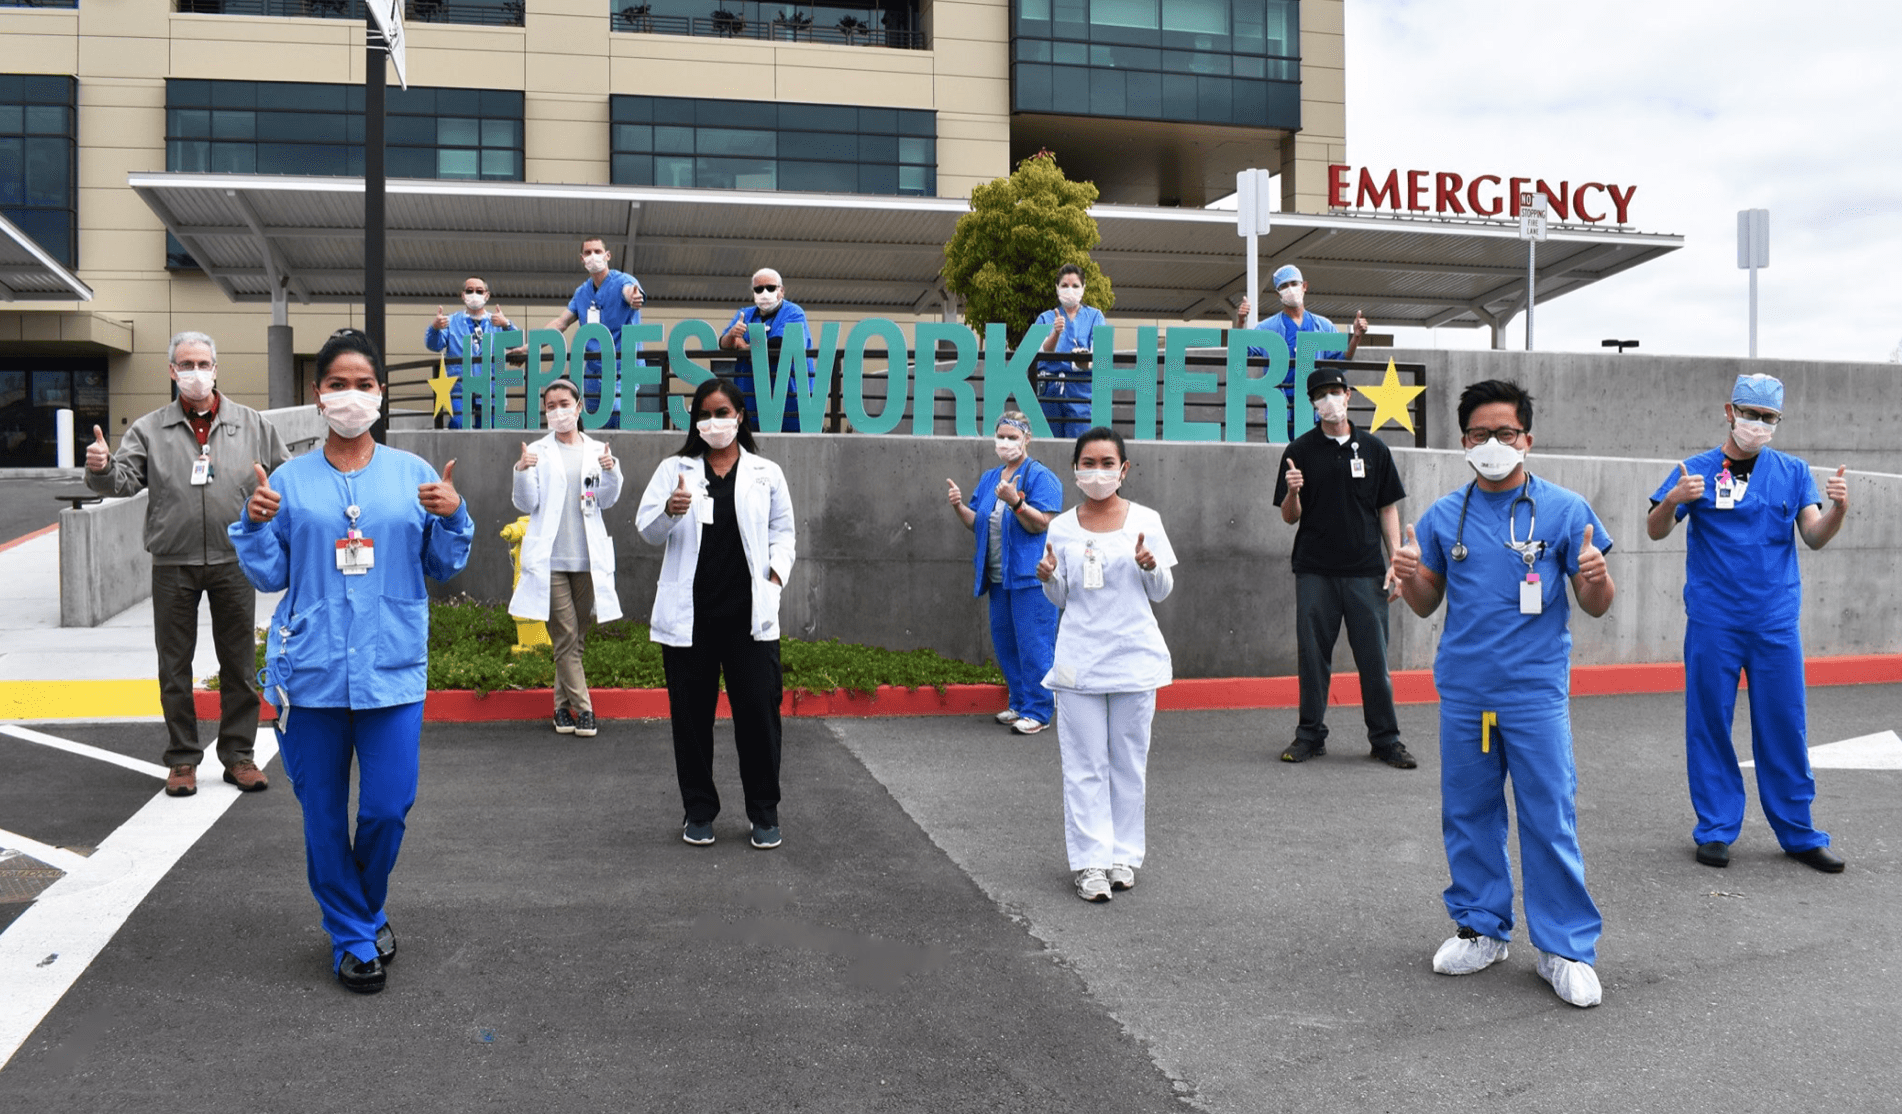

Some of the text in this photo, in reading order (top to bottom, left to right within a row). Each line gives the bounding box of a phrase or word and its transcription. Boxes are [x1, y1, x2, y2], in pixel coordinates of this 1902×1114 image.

[1328, 164, 1637, 224] EMERGENCY
[1521, 194, 1532, 206] NO
[1521, 208, 1545, 218] STOPPING
[1527, 218, 1538, 227] FIRE
[1527, 227, 1538, 236] LANE
[461, 318, 719, 431] HEROES
[749, 317, 1053, 438] WORK
